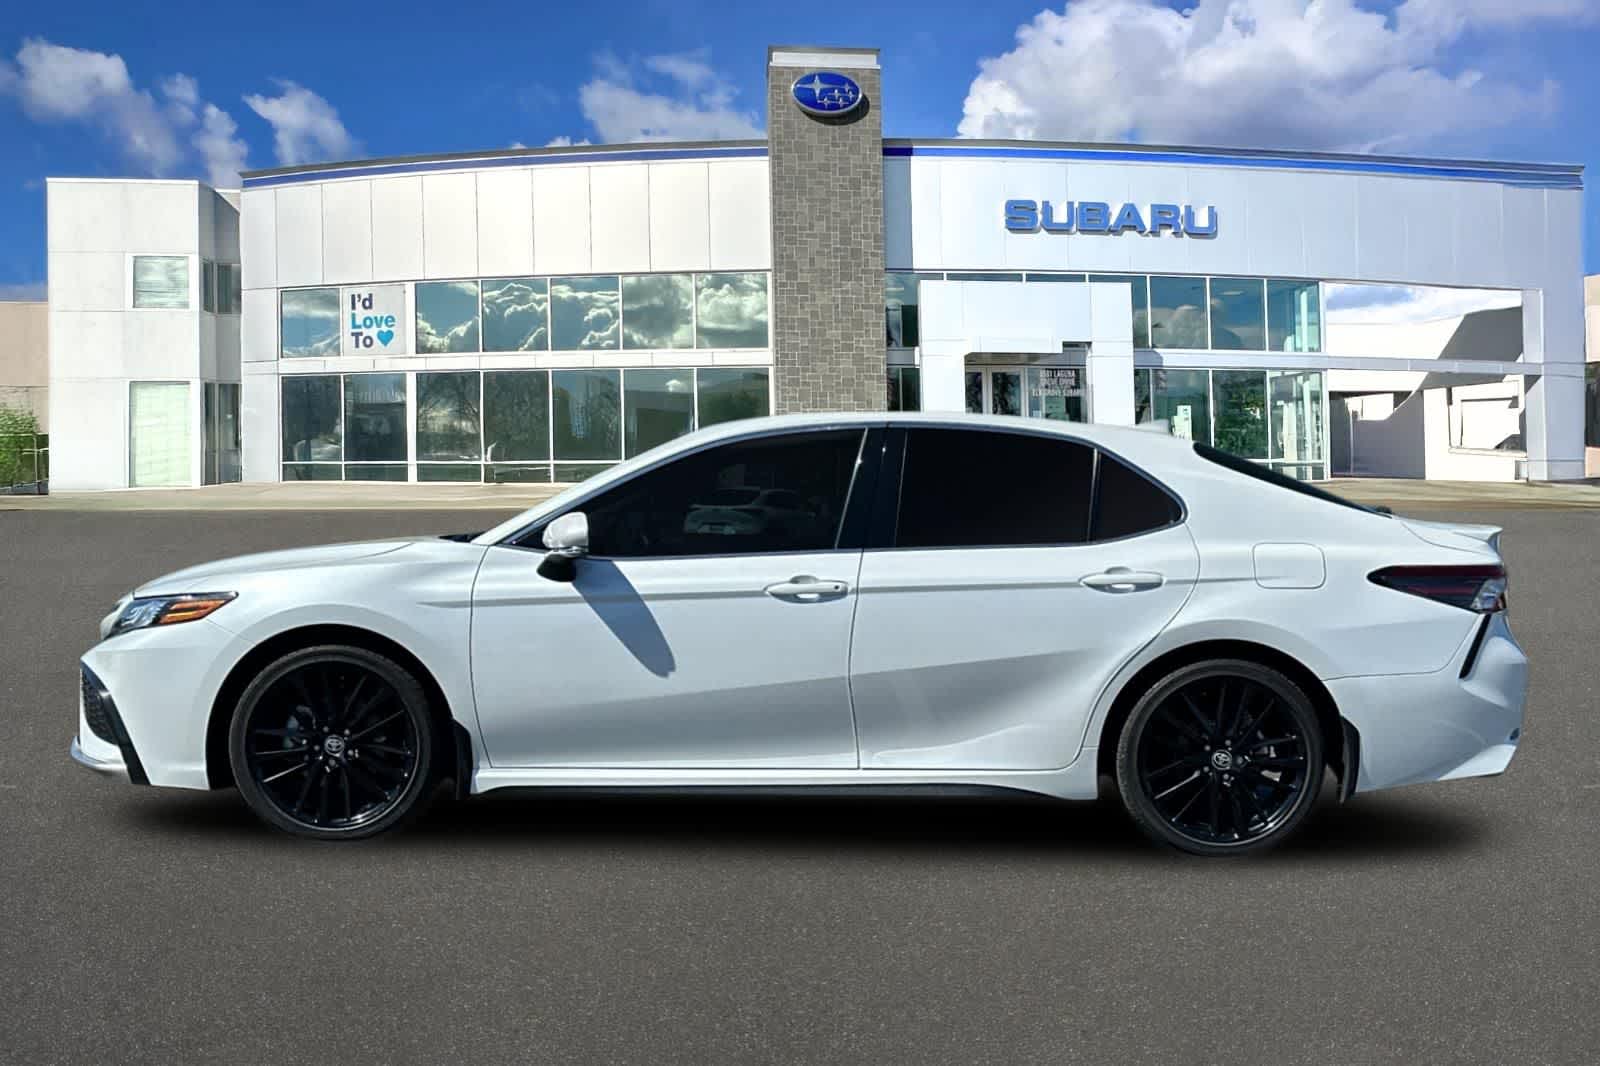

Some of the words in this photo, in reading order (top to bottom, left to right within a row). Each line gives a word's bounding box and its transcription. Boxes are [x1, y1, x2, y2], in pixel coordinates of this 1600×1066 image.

[1005, 199, 1218, 239] SUBARU
[351, 293, 373, 310] I'd
[351, 312, 396, 329] Love
[351, 331, 374, 348] To
